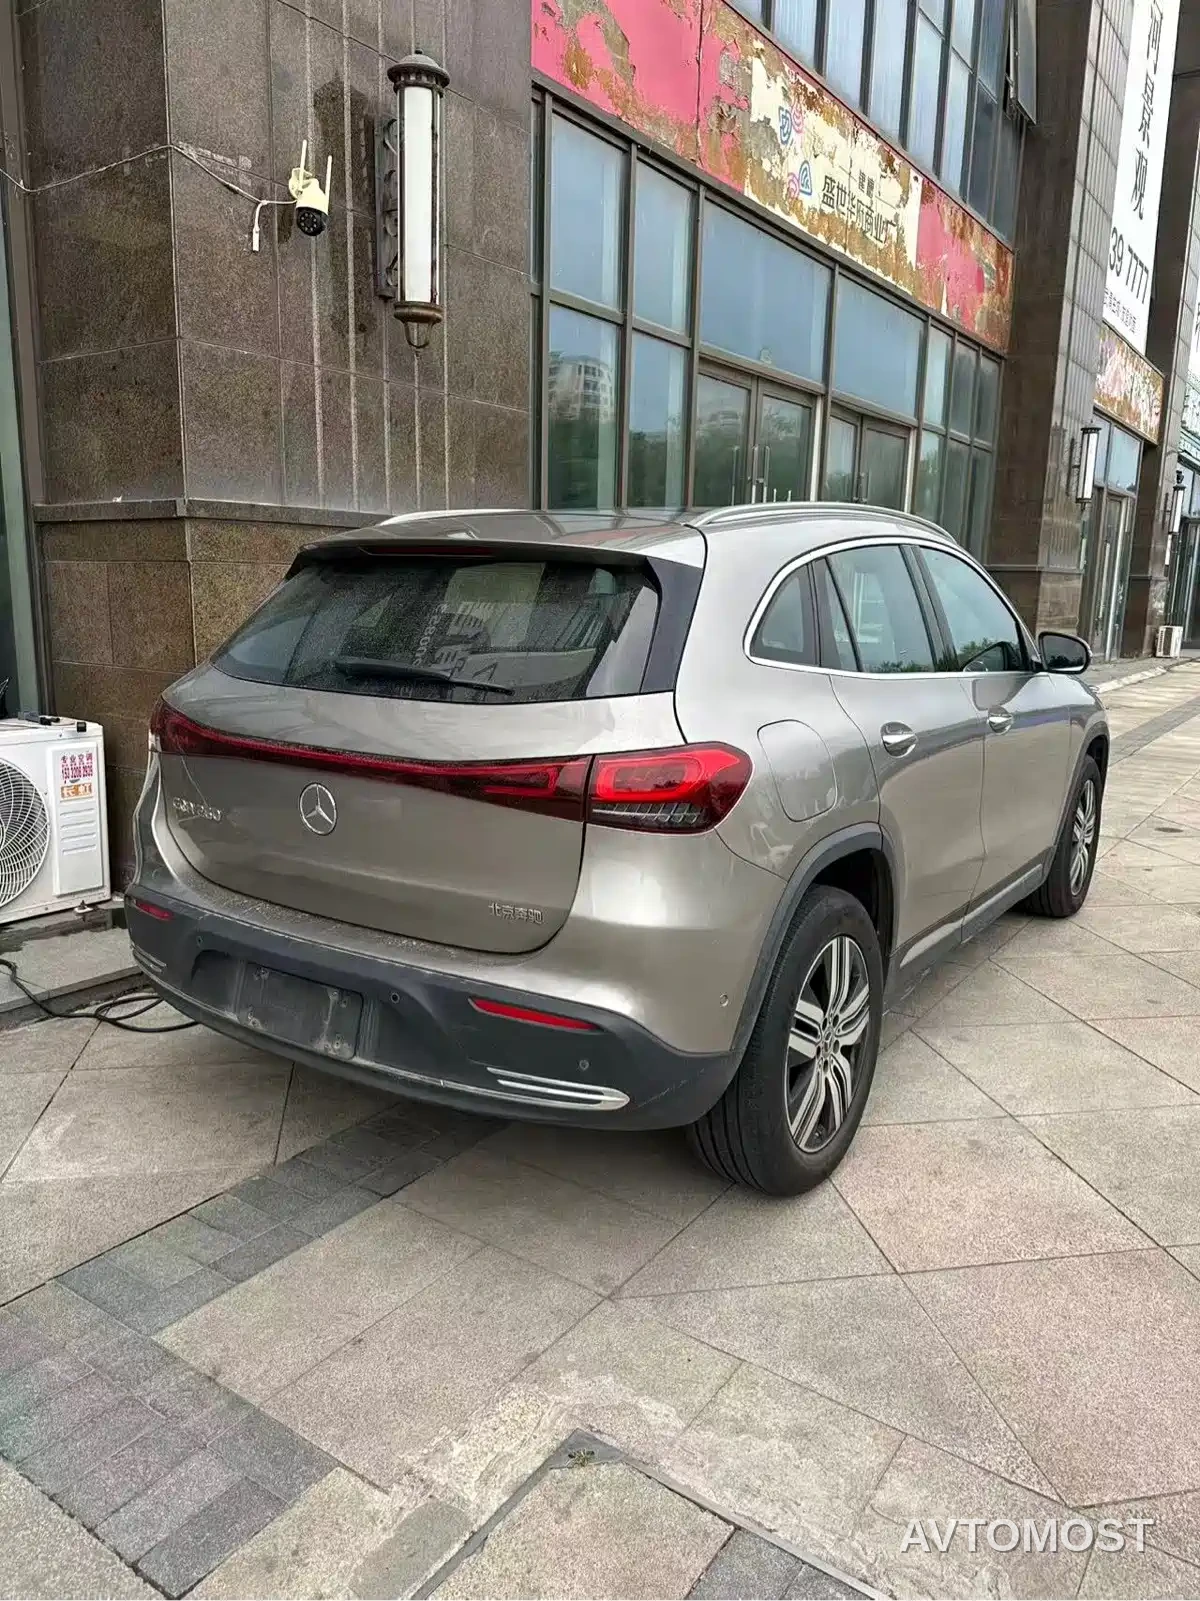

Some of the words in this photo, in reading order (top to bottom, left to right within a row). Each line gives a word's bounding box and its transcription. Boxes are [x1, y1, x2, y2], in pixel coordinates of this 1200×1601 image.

[1109, 226, 1124, 277] 39
[1125, 244, 1149, 304] 7777
[488, 902, 543, 924] 北京奔驰
